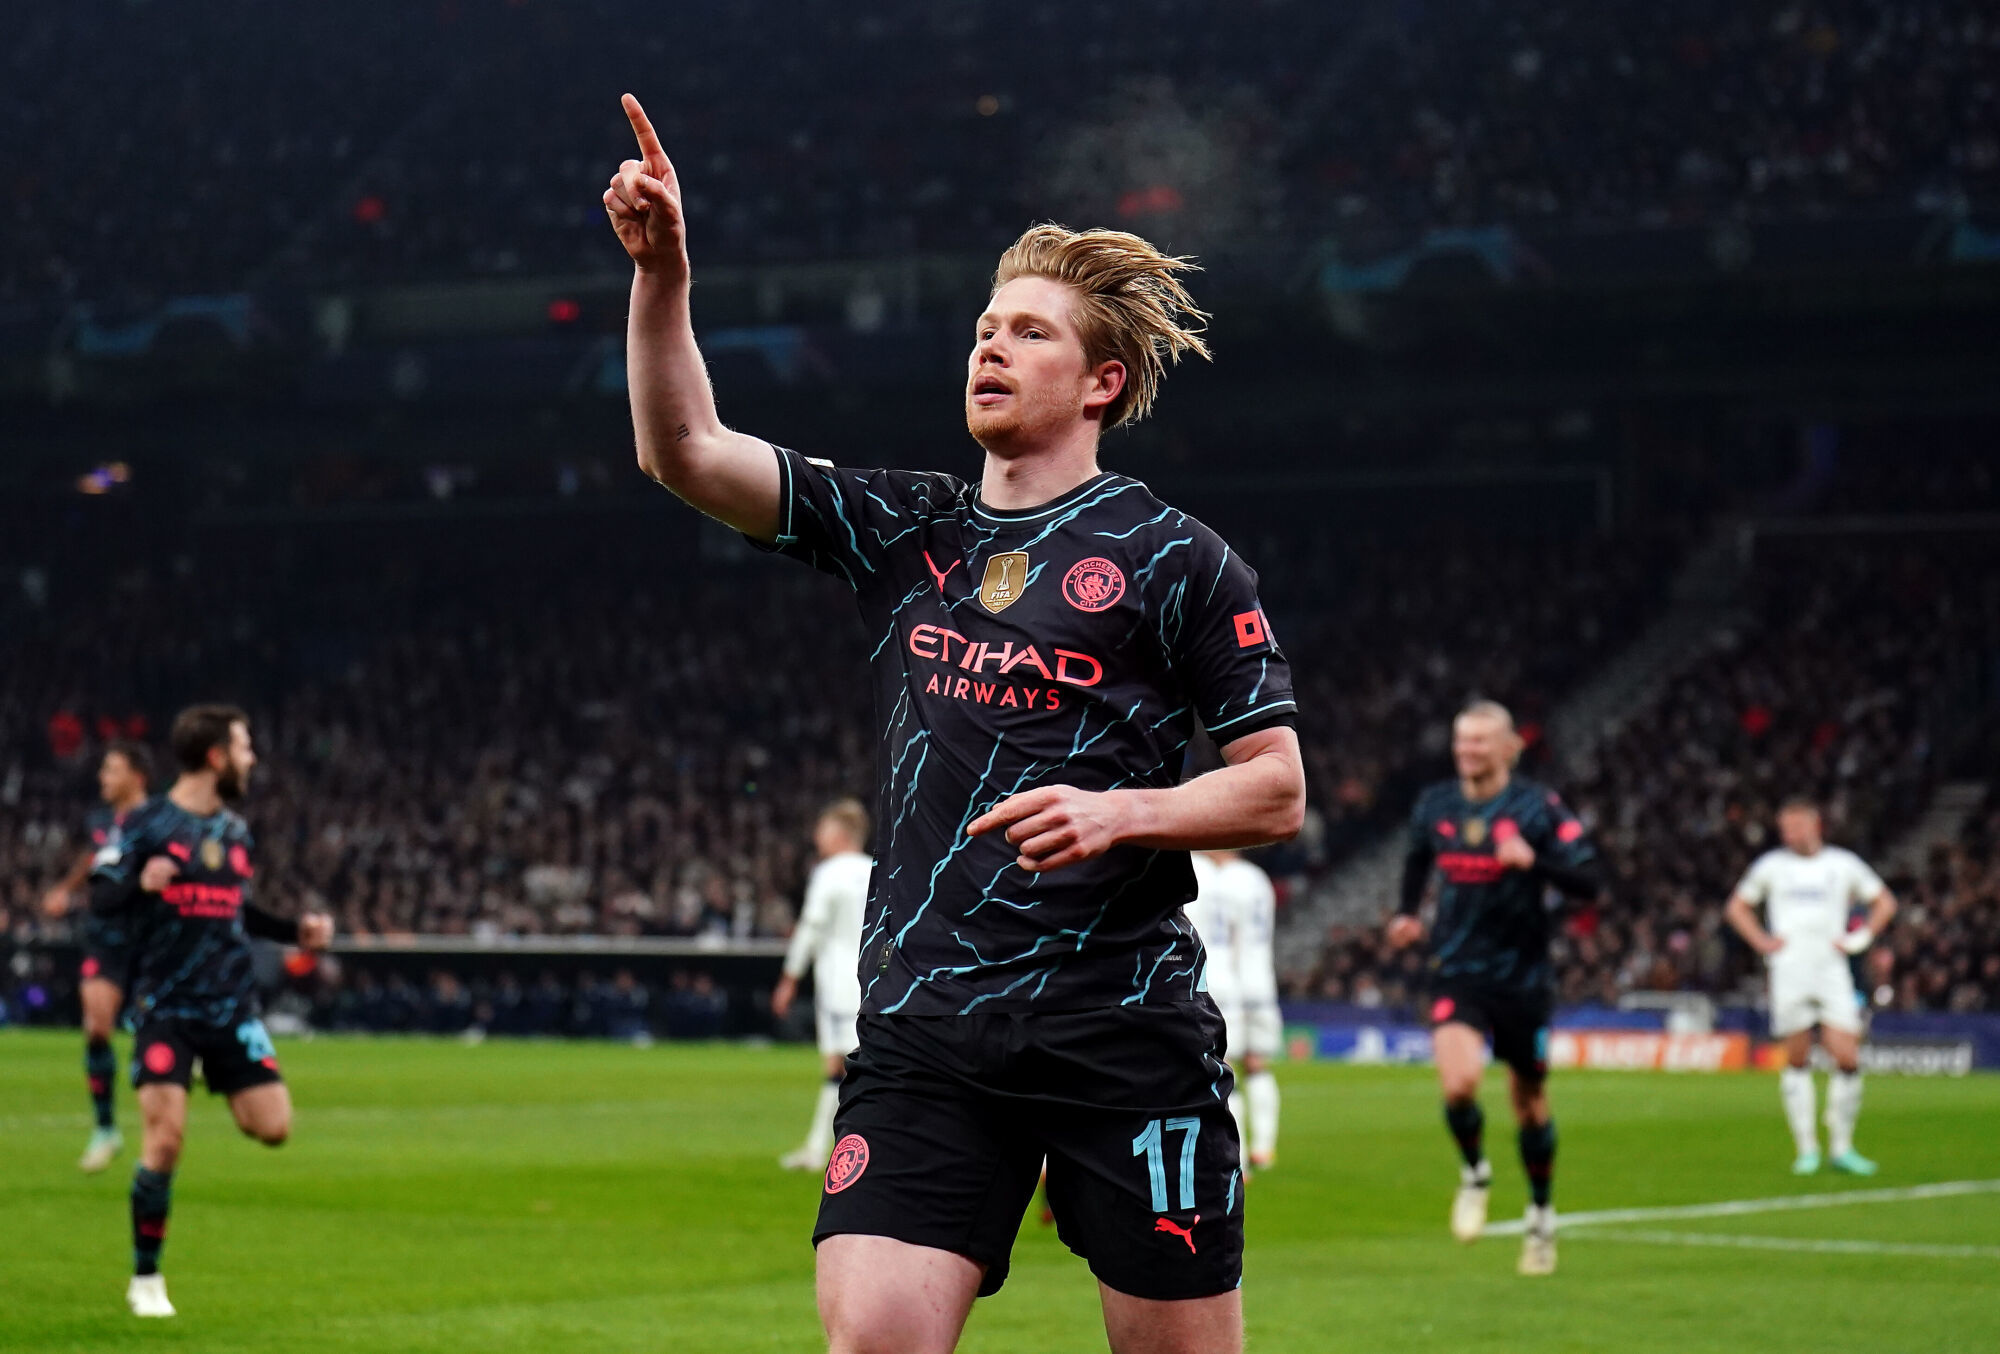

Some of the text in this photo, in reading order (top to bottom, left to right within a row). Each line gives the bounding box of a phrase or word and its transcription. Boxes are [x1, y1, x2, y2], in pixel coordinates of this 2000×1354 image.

[1072, 561, 1121, 583] MANCHESTER
[990, 590, 1011, 600] FIFA
[1079, 600, 1100, 608] CITY
[909, 623, 1103, 687] ETIHAD
[925, 673, 1060, 710] AIRWAYS
[1132, 1116, 1201, 1213] 17
